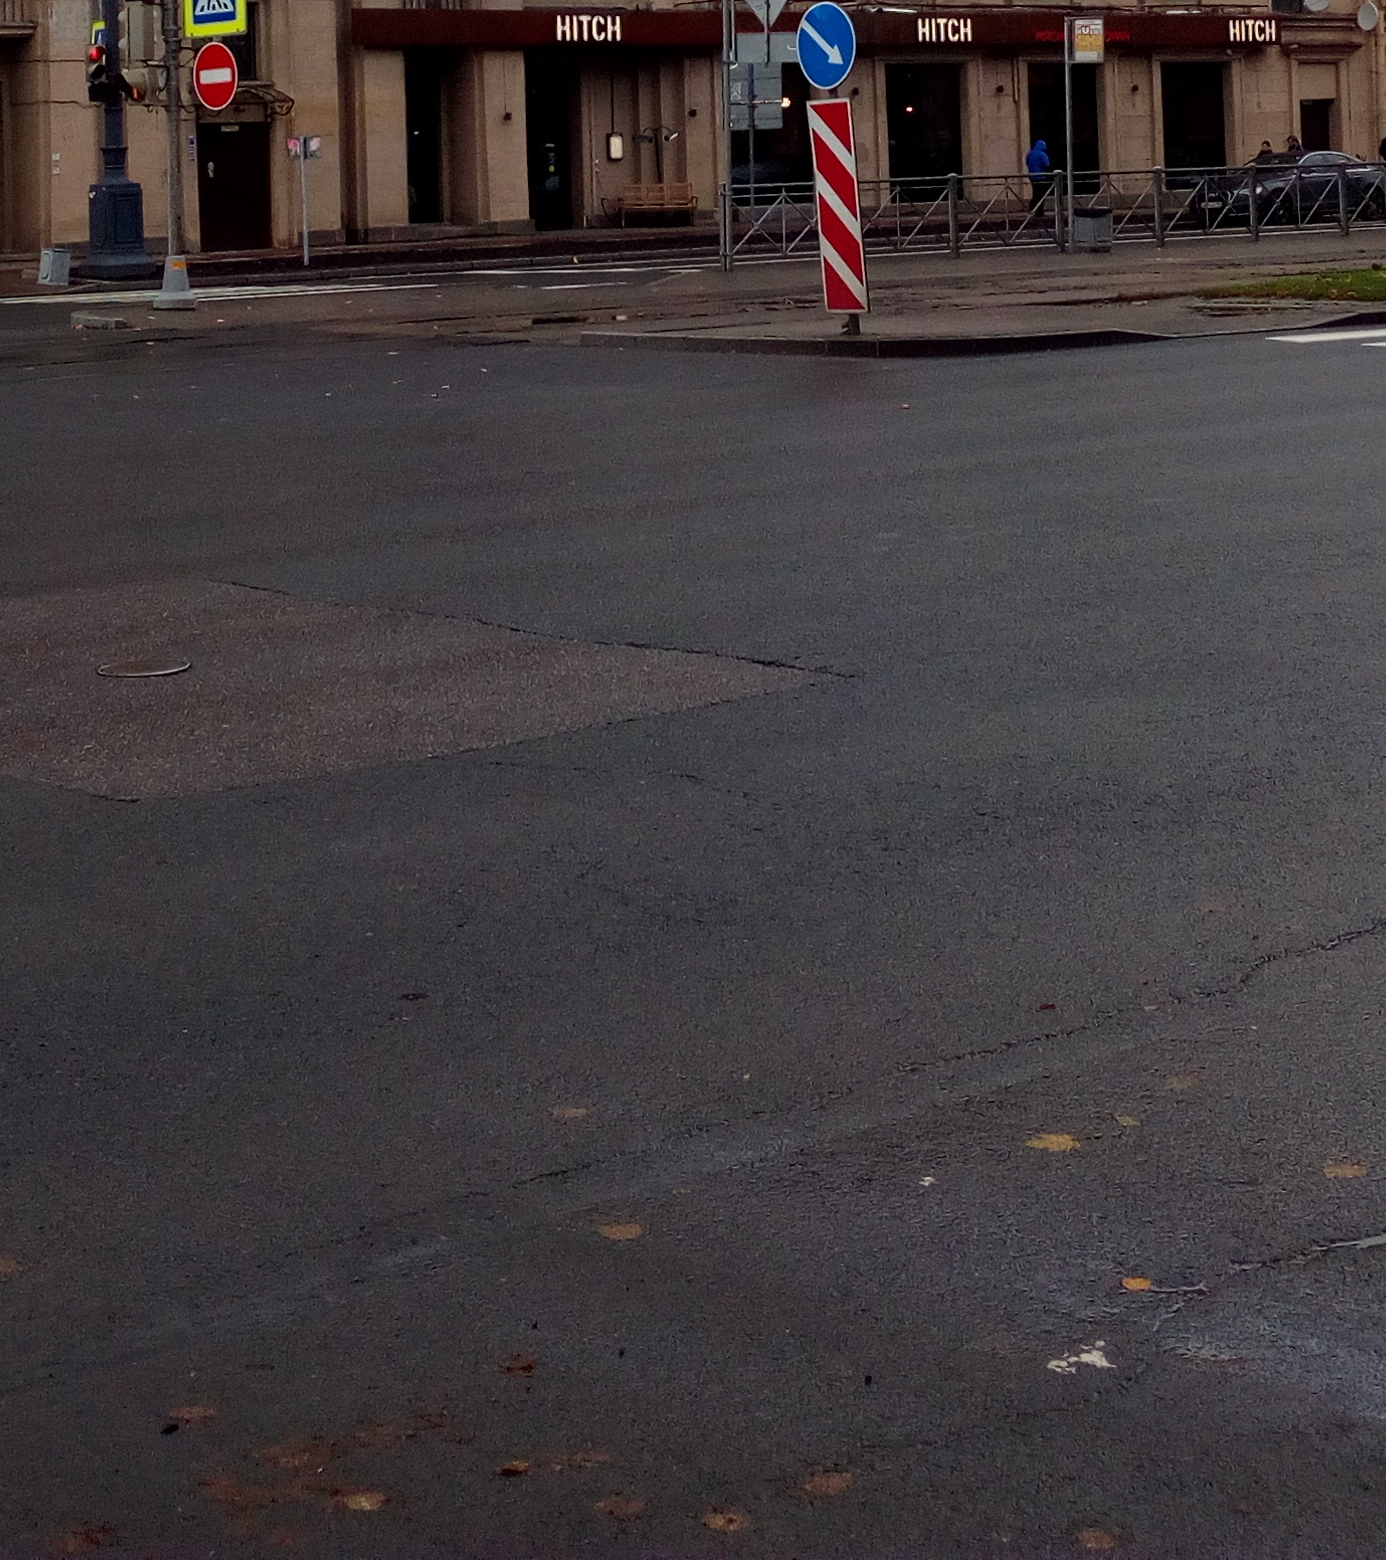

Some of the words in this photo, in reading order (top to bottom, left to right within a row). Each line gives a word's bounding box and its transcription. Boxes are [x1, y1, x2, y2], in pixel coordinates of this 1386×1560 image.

[556, 14, 621, 41] HITCH
[917, 18, 972, 42] HITCH
[1229, 19, 1276, 42] HITCH
